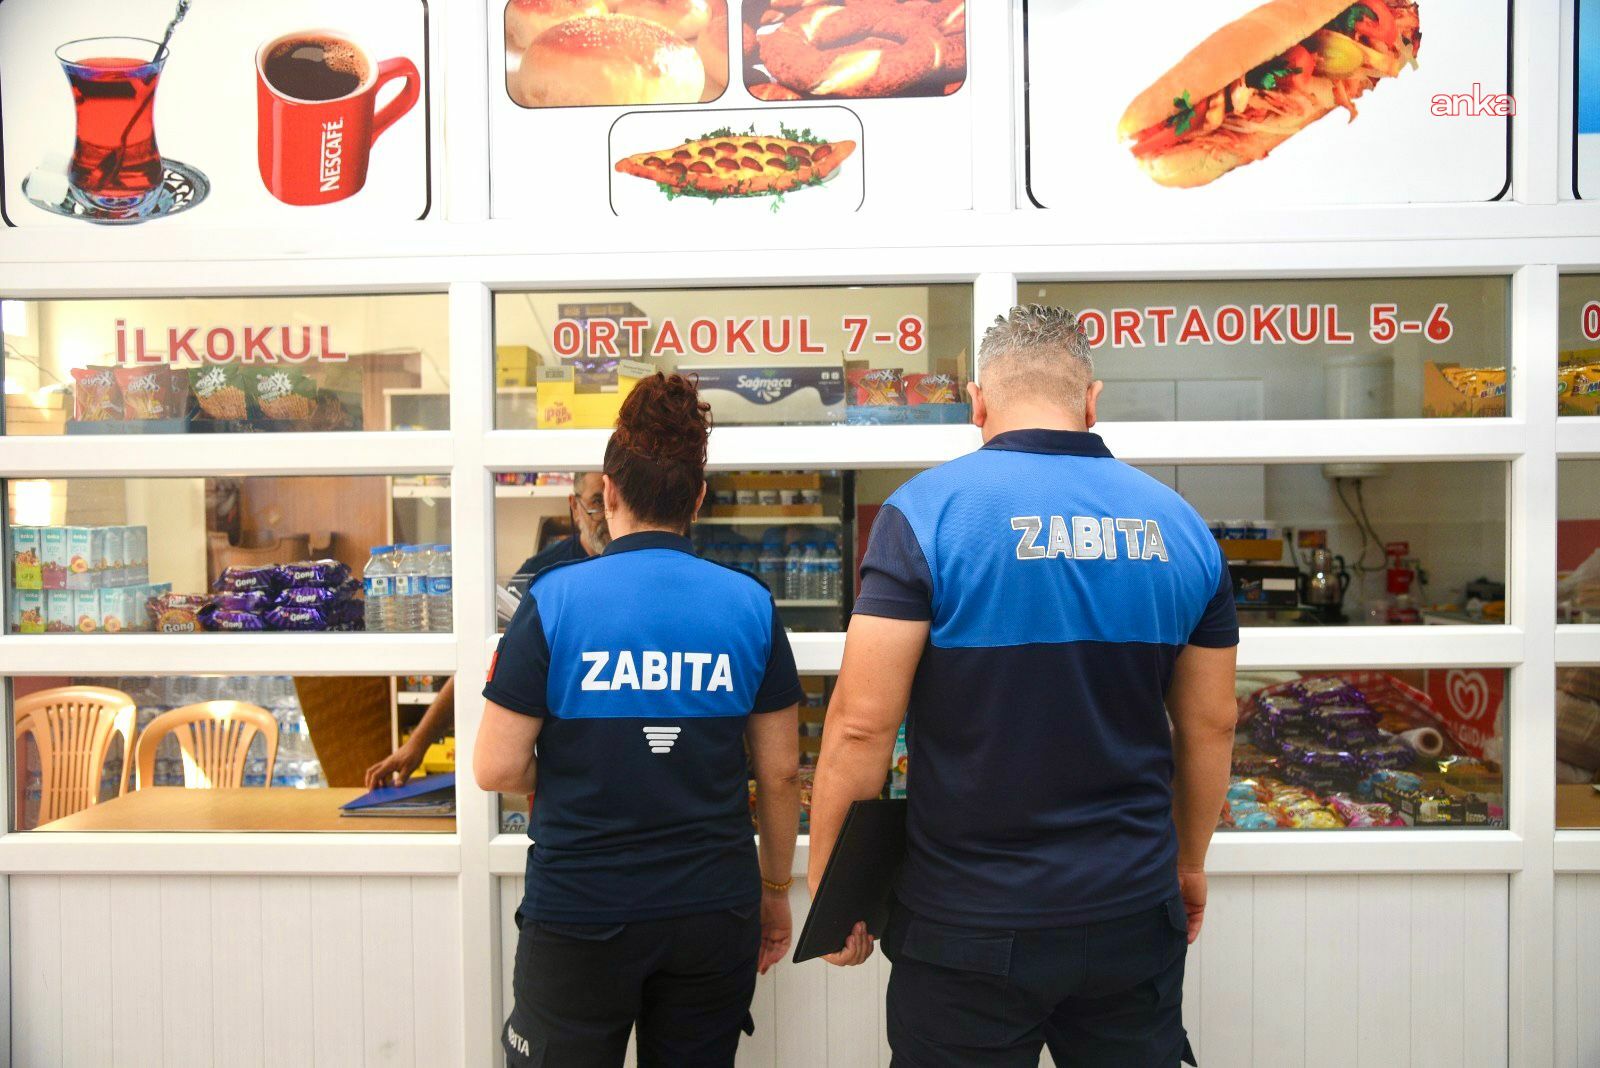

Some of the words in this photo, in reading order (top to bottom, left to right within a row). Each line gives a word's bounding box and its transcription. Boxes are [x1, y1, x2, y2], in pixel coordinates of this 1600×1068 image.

[319, 117, 345, 192] NESCAFÉ
[114, 318, 349, 364] İLKOKUL
[553, 316, 826, 357] ORTAOKUL
[844, 315, 925, 353] 7-8
[1076, 304, 1354, 348] ORTAOKUL
[1370, 304, 1453, 344] 5-6
[1011, 516, 1169, 562] ZABITA
[235, 577, 257, 587] Gong
[294, 570, 315, 579] Gong
[163, 621, 195, 633] Gong
[289, 613, 310, 622] Gong
[581, 651, 734, 691] ZABITA
